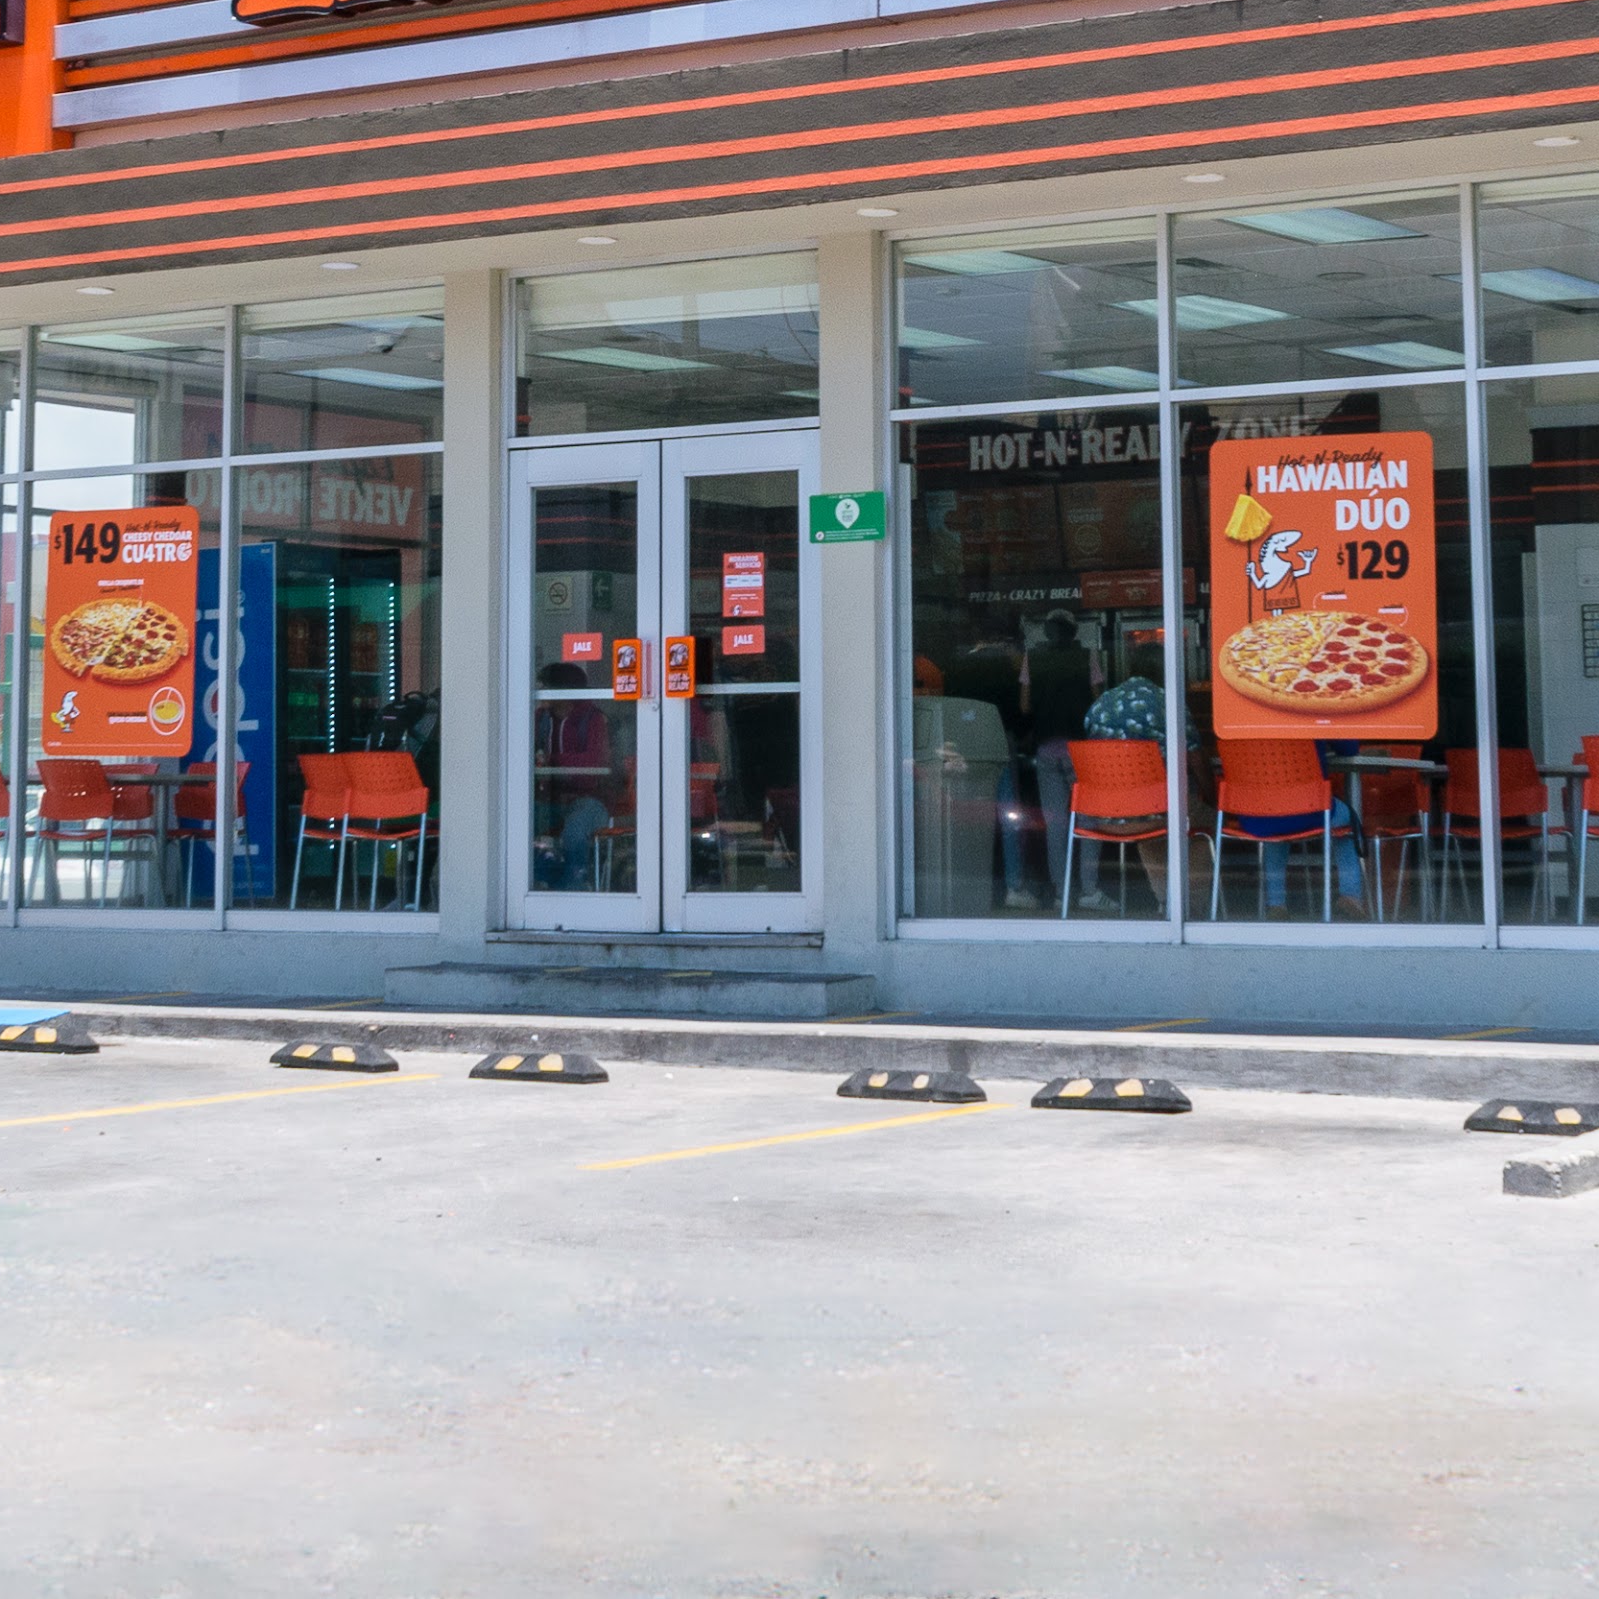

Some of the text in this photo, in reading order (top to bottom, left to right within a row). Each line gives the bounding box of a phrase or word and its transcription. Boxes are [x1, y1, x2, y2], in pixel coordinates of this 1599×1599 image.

[1257, 460, 1408, 494] HAWAIIAN
[1335, 488, 1411, 532] DÚO
[54, 521, 120, 565] $149
[1336, 539, 1410, 580] $129
[1049, 587, 1083, 600] BREA
[572, 641, 592, 655] JALE
[733, 634, 754, 647] JALE
